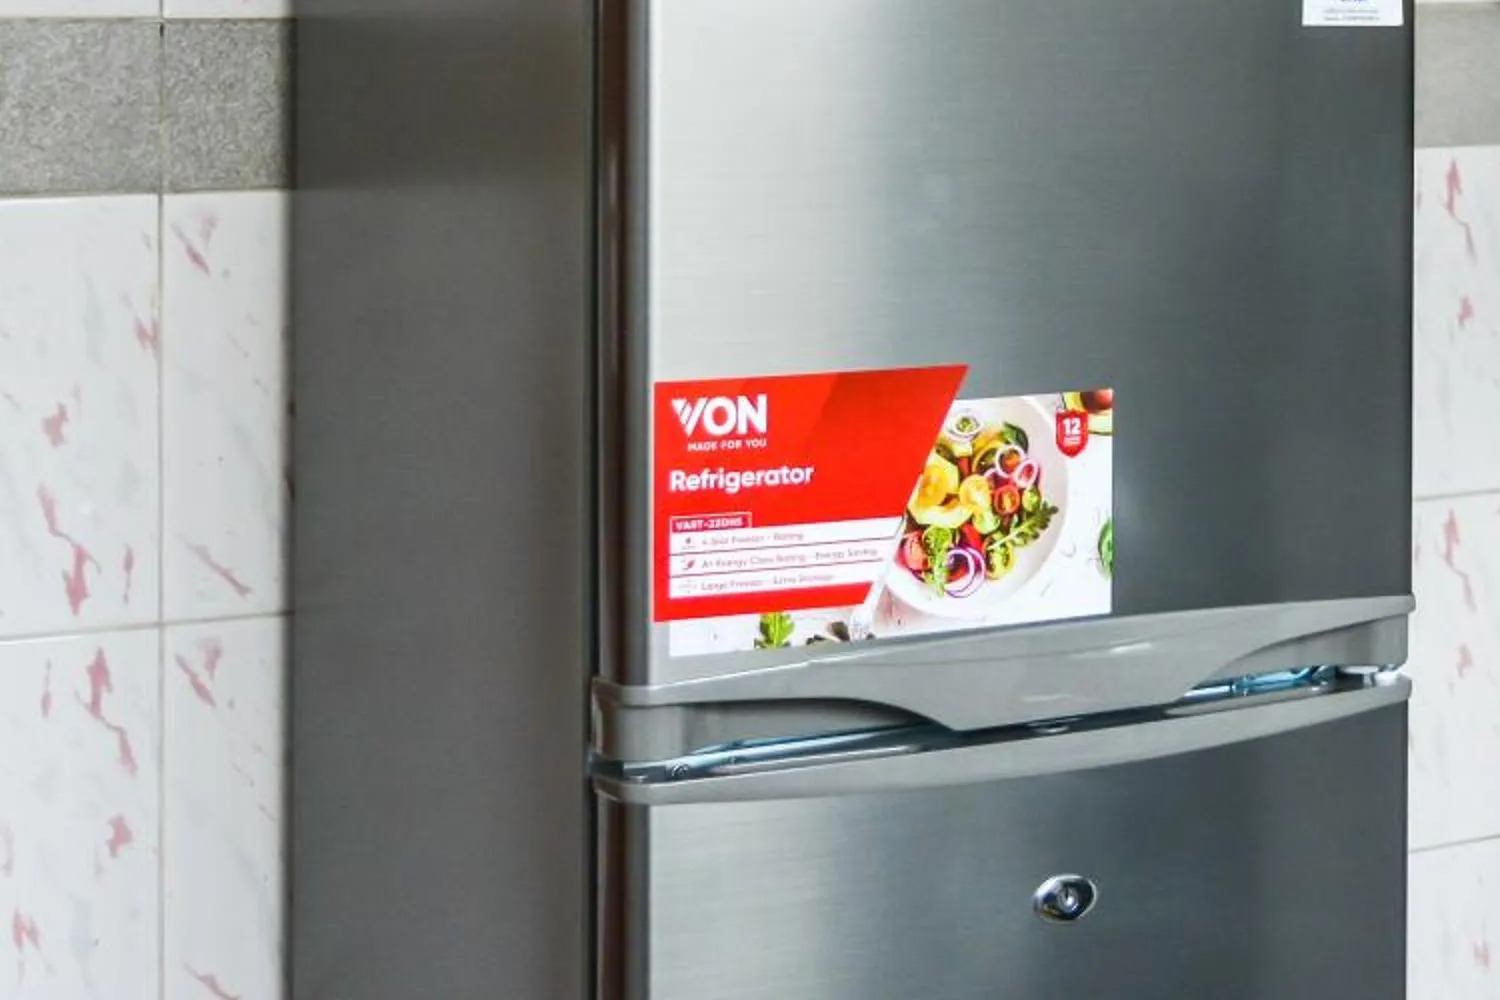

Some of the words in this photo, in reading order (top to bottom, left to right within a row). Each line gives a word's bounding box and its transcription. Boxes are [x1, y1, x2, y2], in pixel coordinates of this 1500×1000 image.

[671, 394, 768, 436] VON
[1063, 417, 1081, 435] 12
[688, 441, 717, 451] MADE
[720, 439, 742, 450] FOR
[745, 438, 767, 448] YOU
[670, 465, 814, 494] Refrigerator
